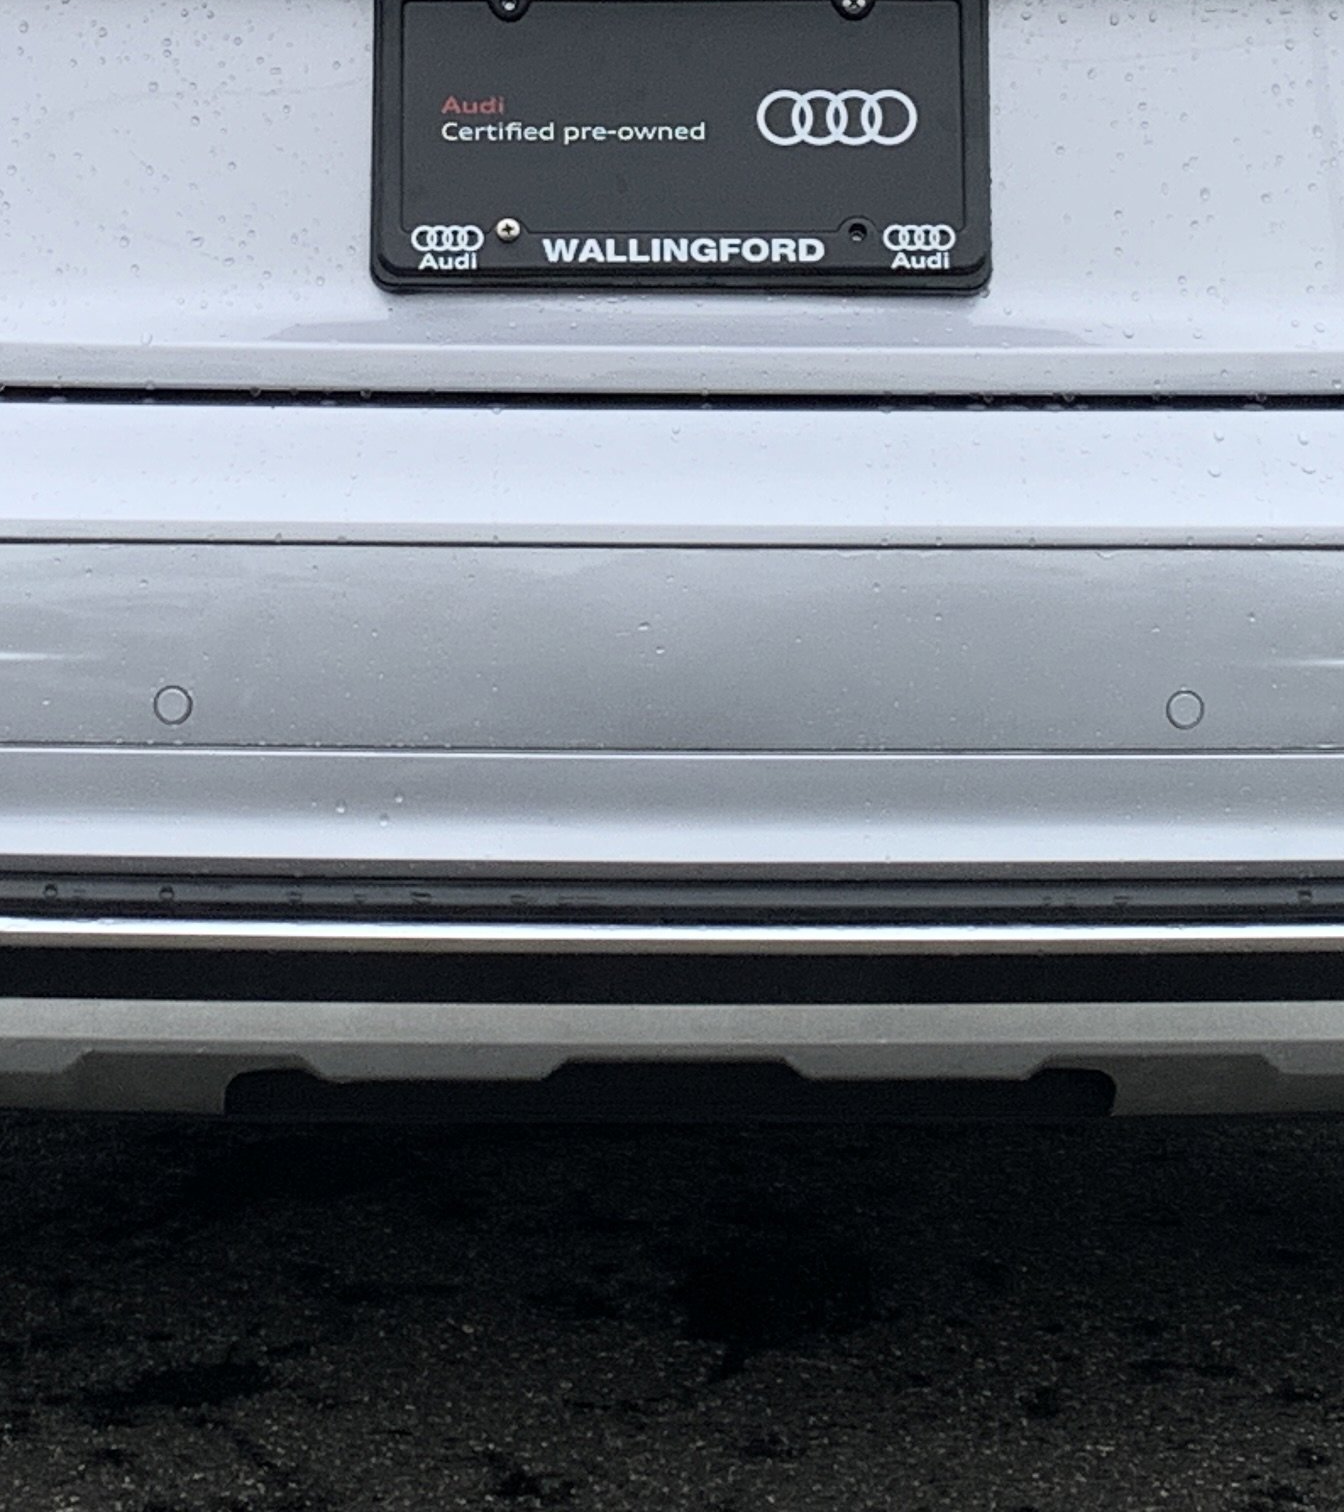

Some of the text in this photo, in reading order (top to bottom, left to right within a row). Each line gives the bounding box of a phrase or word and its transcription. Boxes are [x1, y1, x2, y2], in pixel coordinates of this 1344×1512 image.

[441, 95, 504, 114] Audi
[441, 121, 706, 145] Certified pre-owned
[542, 237, 826, 263] WALLINGFORD
[417, 252, 477, 270] Audi
[890, 251, 951, 269] Audi
